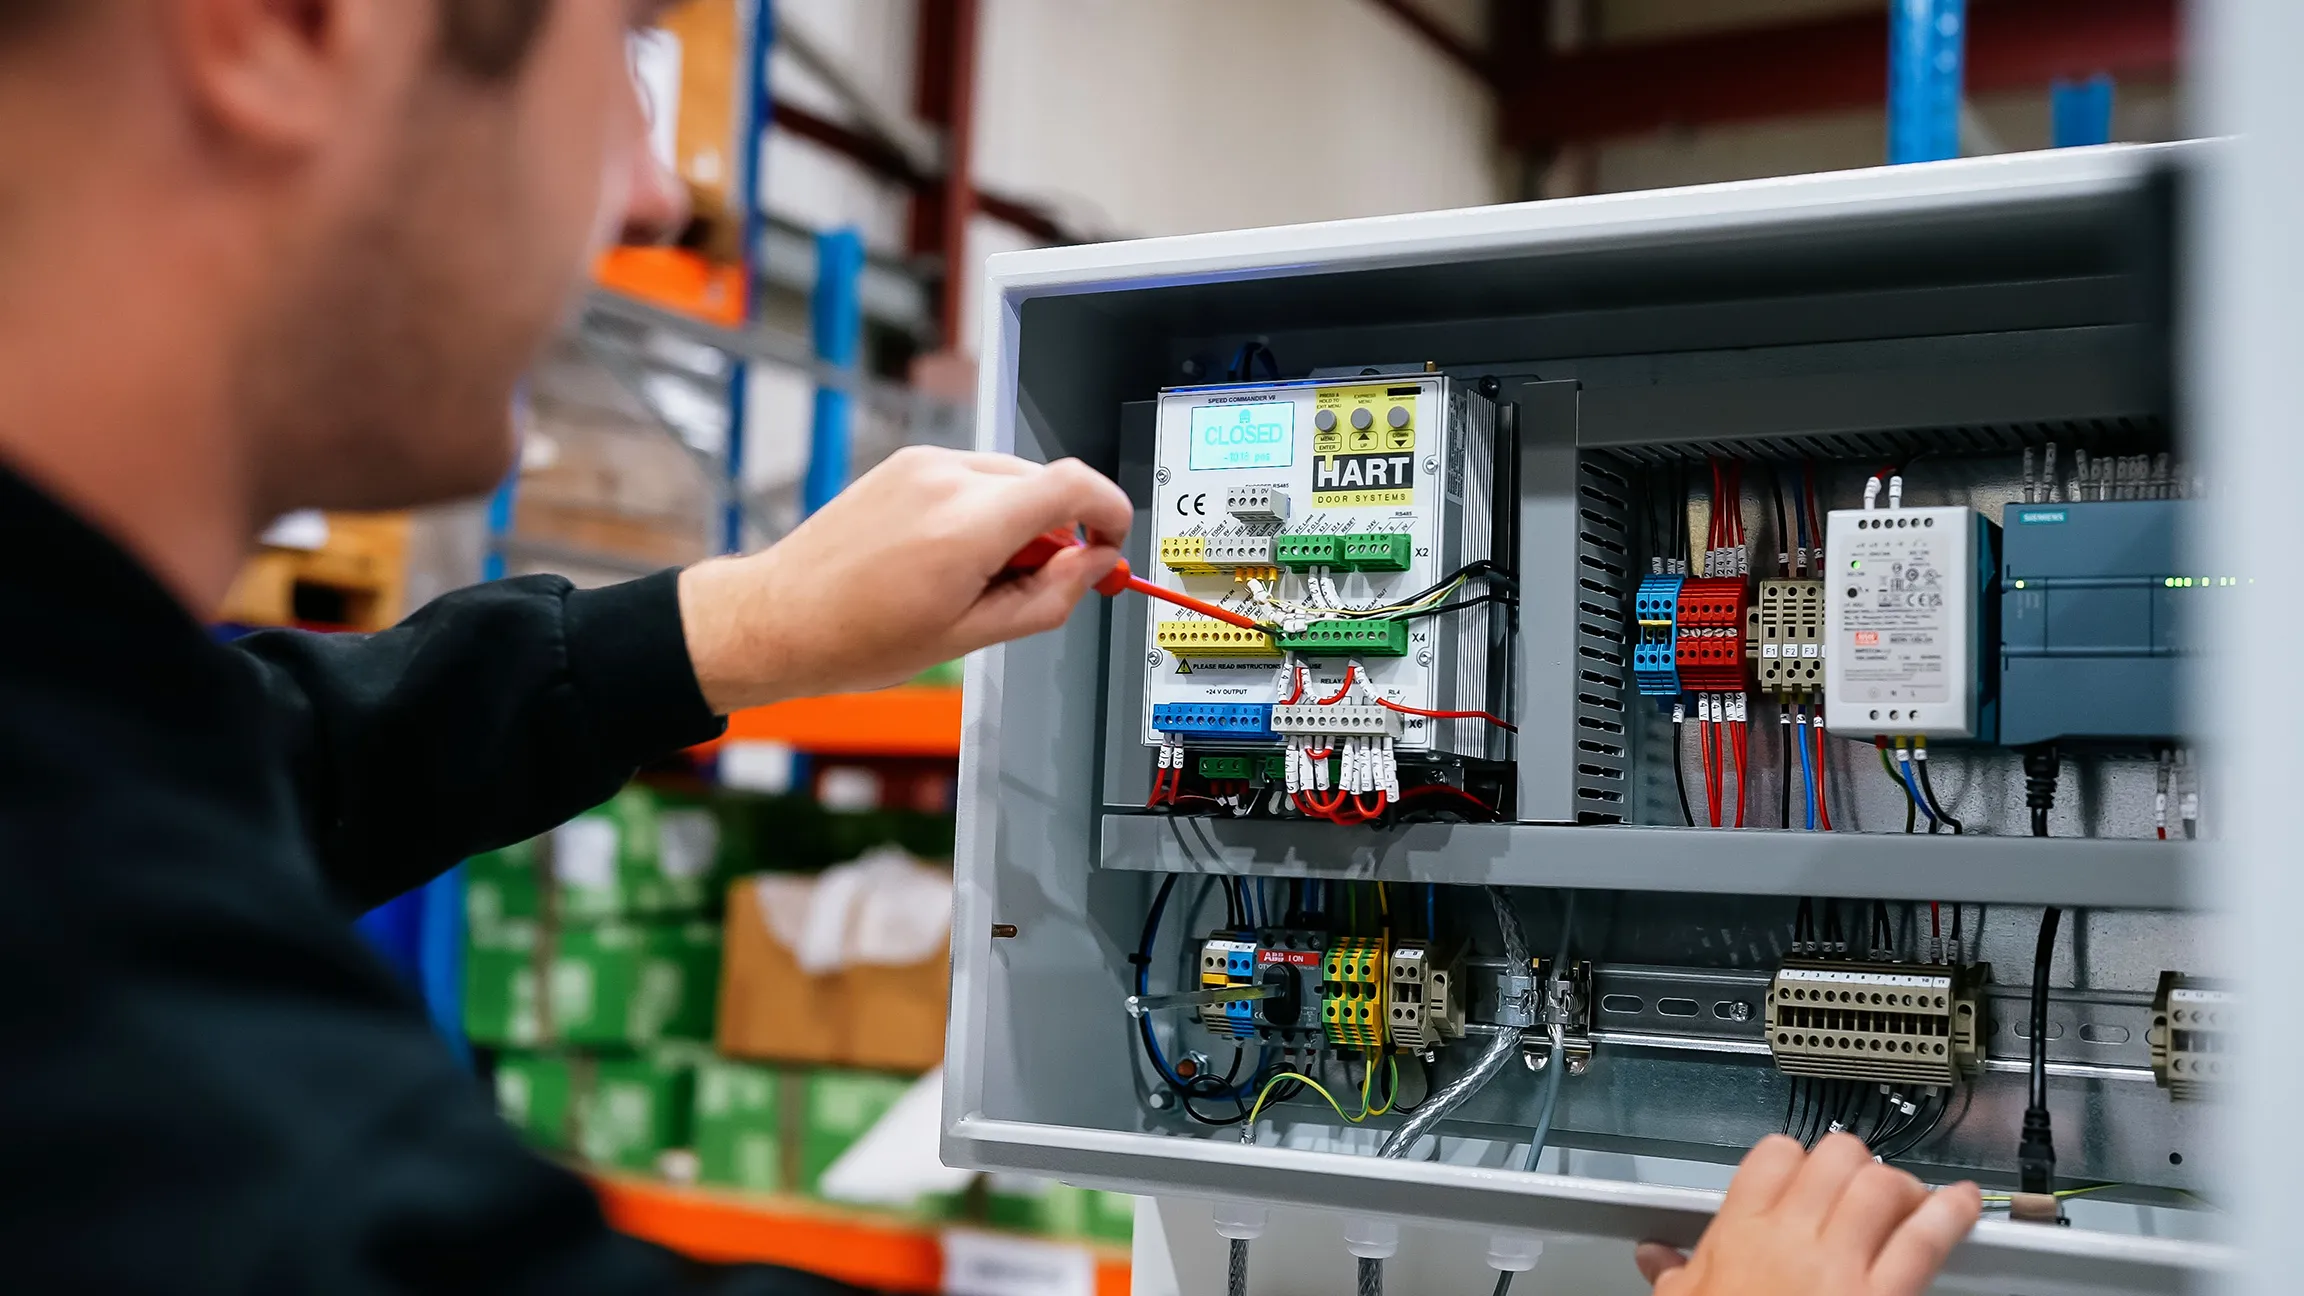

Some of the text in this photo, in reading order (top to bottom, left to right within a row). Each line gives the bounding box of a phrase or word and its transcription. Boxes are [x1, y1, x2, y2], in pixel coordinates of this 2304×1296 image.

[1205, 424, 1283, 446] CLOSED
[1318, 457, 1410, 487] HART
[1318, 494, 1406, 503] DOOR SYSTEMS
[1341, 517, 1356, 532] RESET
[1415, 548, 1429, 557] X2
[1412, 634, 1425, 642] X4
[1725, 694, 1733, 718] 24V
[1409, 719, 1423, 729] X6
[1264, 952, 1284, 962] ABB
